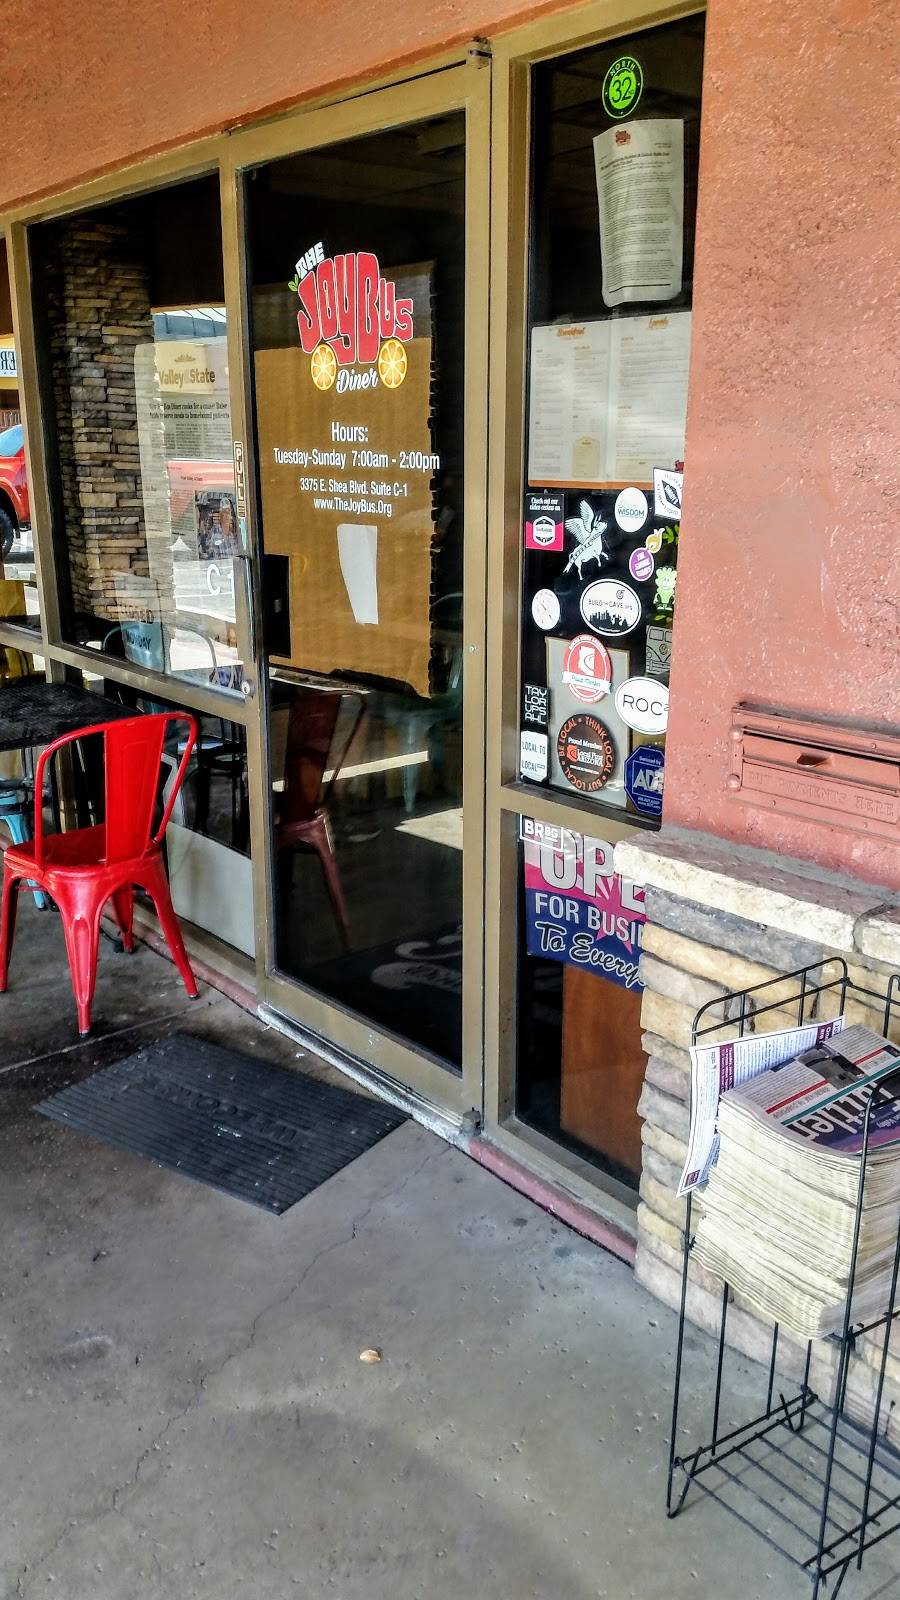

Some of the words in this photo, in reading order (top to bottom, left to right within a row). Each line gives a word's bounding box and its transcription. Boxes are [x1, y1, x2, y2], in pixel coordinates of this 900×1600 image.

[610, 61, 635, 76] NORTH
[612, 77, 632, 103] 32
[295, 241, 325, 279] THE
[160, 369, 184, 388] Valley
[189, 368, 216, 383] State
[336, 367, 378, 393] Diner
[331, 421, 369, 442] Hours:
[273, 447, 346, 469] Tuesday-Sunday
[351, 450, 389, 468] 7:00am
[399, 451, 440, 472] 2:00pm
[235, 446, 245, 500] PULL
[299, 477, 318, 492] 3375
[319, 479, 327, 492] E.
[328, 478, 348, 493] Shea
[349, 480, 368, 494] Blvd.
[370, 481, 391, 496] Suite
[393, 483, 408, 497] C-1
[313, 497, 392, 518] www.TheJoyBus.Org
[618, 508, 645, 516] WISDOM
[525, 685, 547, 698] TAY
[525, 694, 547, 706] LOR
[559, 718, 577, 743] LOCAL
[585, 716, 607, 739] THINK
[522, 741, 538, 753] LOCAL
[539, 745, 546, 754] TO
[559, 745, 565, 756] BE
[568, 737, 582, 746] Proud
[521, 760, 537, 772] LOCAL
[577, 755, 604, 767] ARIZONA
[603, 740, 613, 773] LOCAL
[565, 767, 586, 791] LOCAL
[588, 778, 603, 791] BUY
[855, 795, 894, 817] HERE
[535, 892, 580, 924] FOR
[535, 921, 567, 952] To
